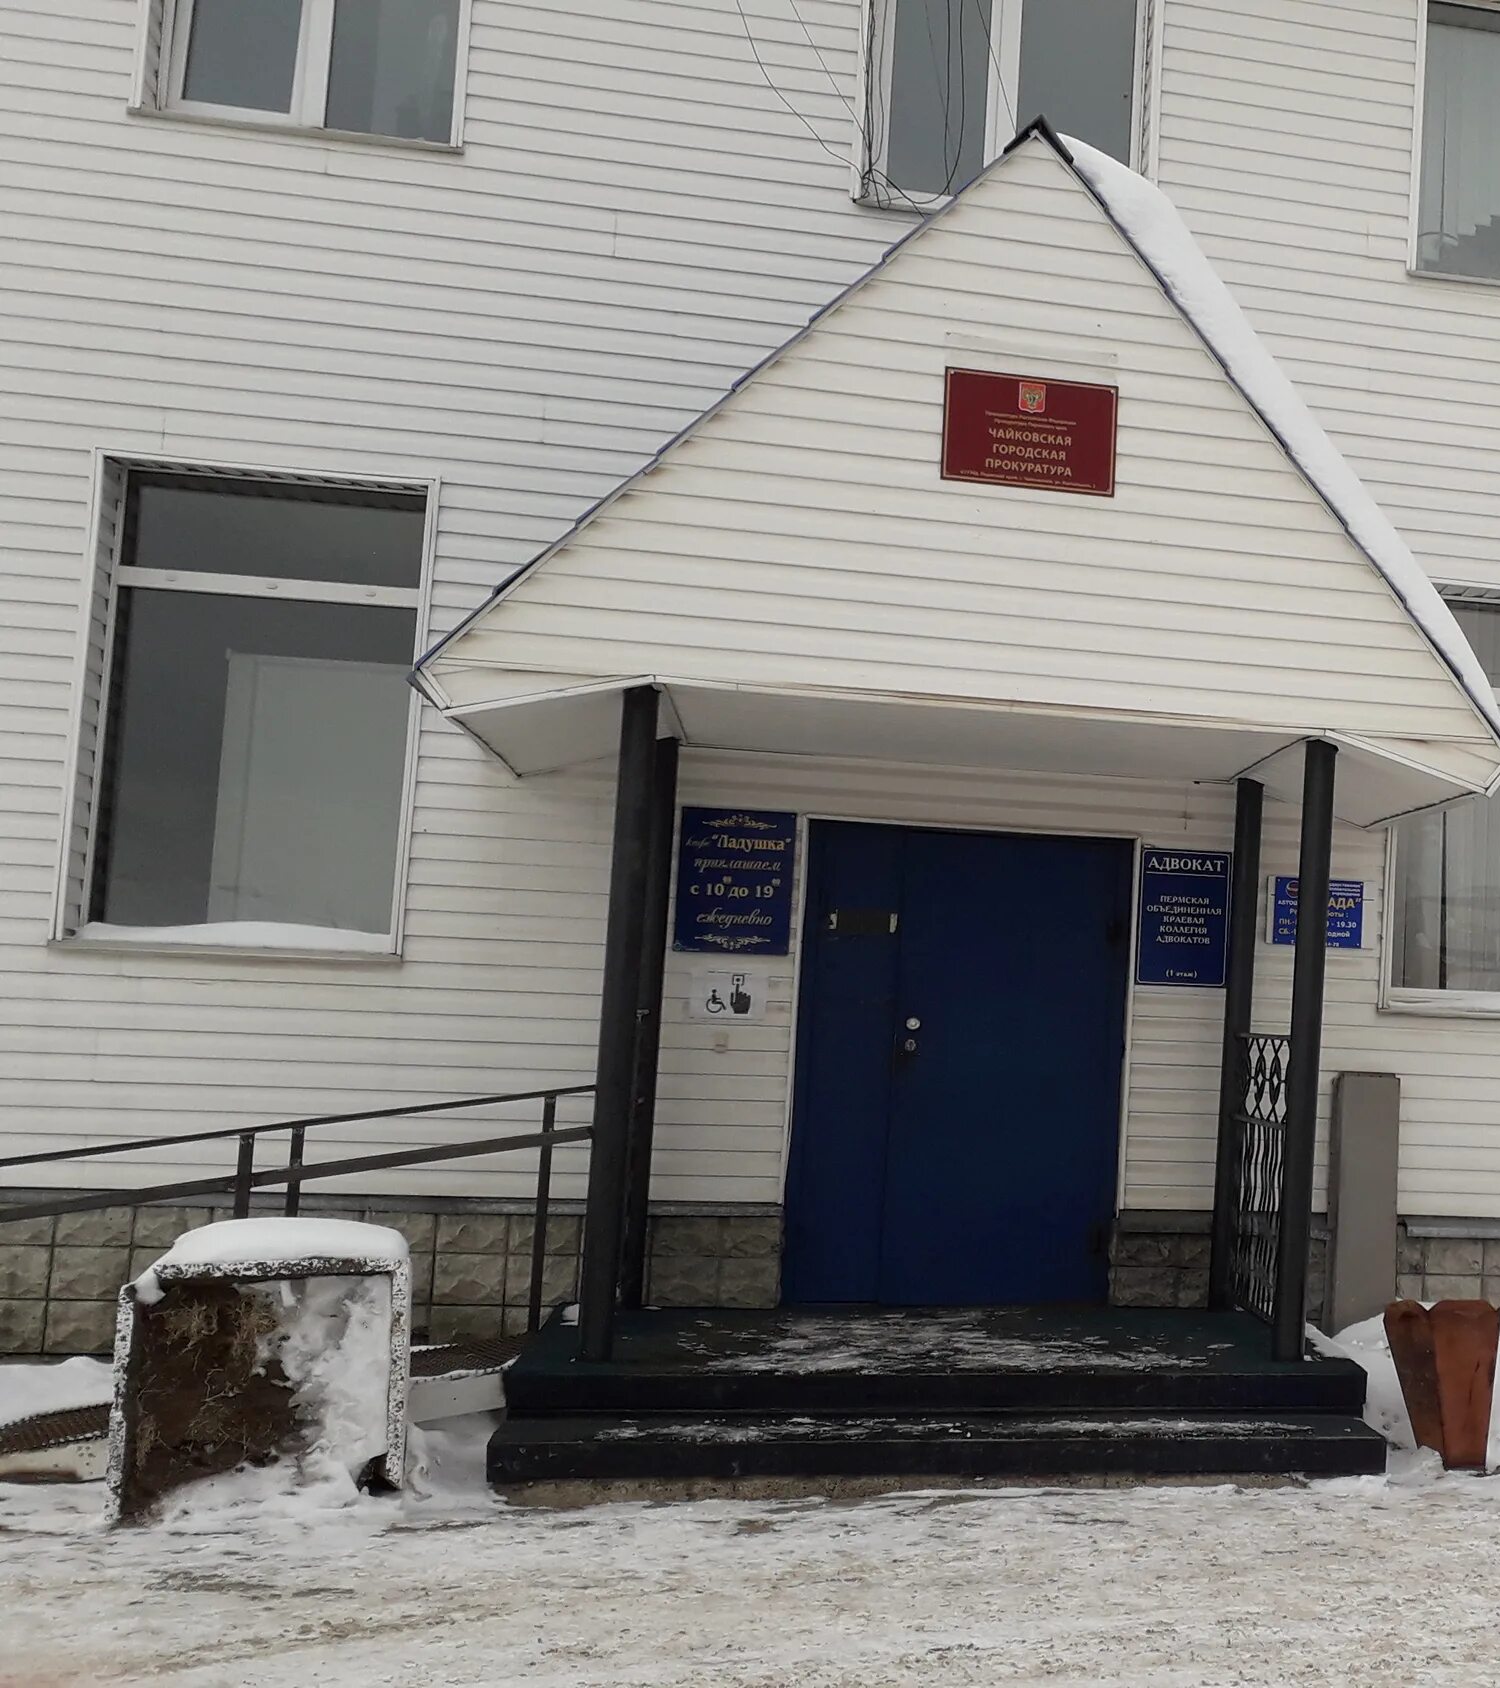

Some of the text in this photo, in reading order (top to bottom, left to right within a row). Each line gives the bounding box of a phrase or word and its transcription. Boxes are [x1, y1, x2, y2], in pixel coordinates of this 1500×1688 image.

[988, 426, 1072, 447] ЧАЙКОВСКАЯ
[992, 443, 1066, 461] ГОРОДСКАЯ
[985, 458, 1072, 477] ПРОКУРАТУРА
[694, 858, 782, 873] приглашаем
[1148, 856, 1225, 872] АДВОКАТ
[690, 884, 700, 895] с
[727, 885, 749, 899] до
[1159, 894, 1210, 905] ПЕРМСКАЯ
[1328, 896, 1362, 910] АДА"
[1146, 904, 1222, 916] ОБЪЕДИНЕННАЯ
[696, 906, 773, 929] ежедневно
[1162, 915, 1205, 925] КРАЕВАЯ
[1159, 925, 1208, 935] КОЛЛЕГИЯ
[1327, 930, 1351, 938] одной
[1155, 934, 1211, 945] АДВОКАТОВ
